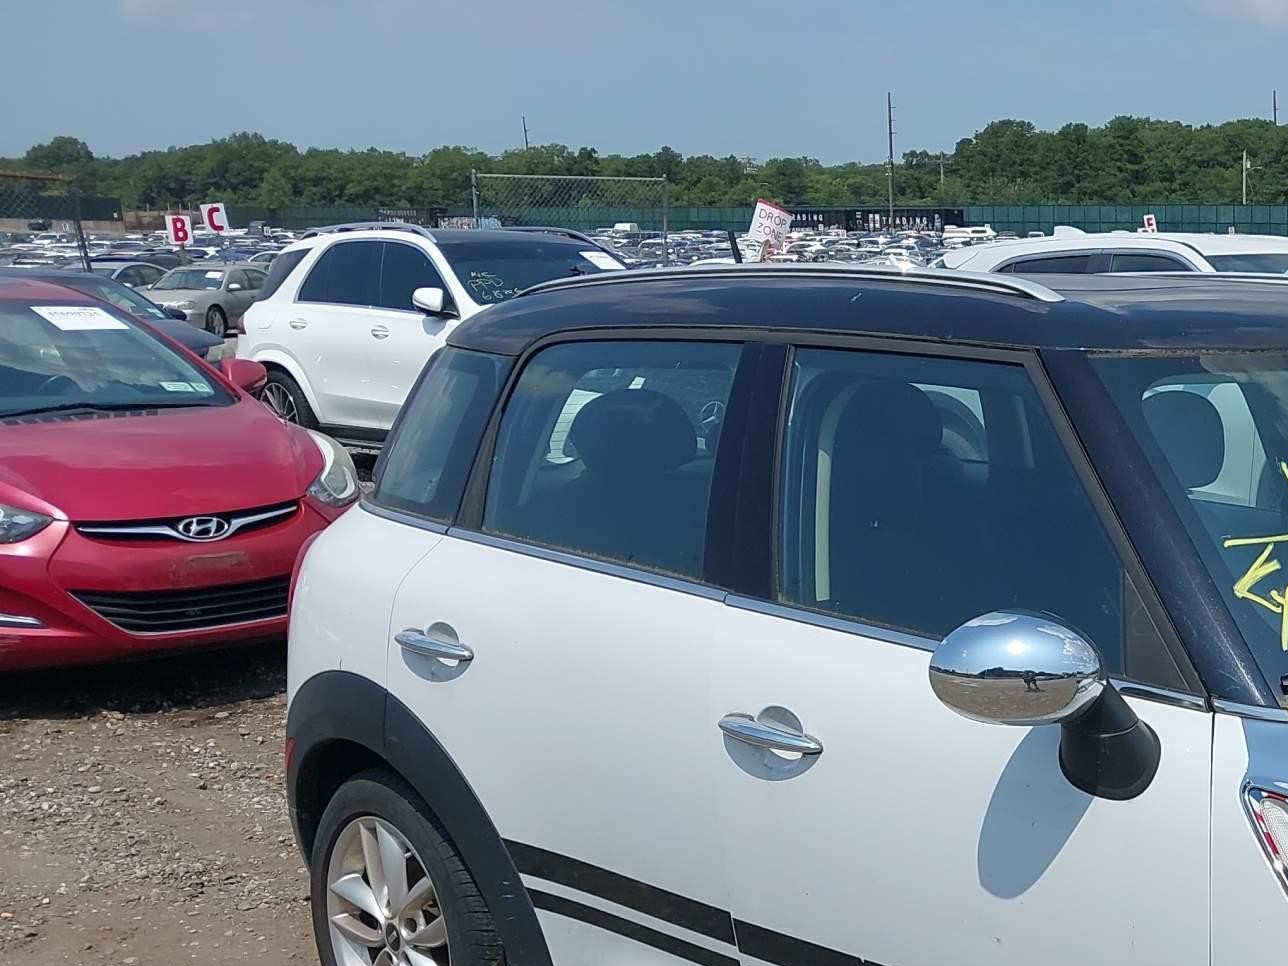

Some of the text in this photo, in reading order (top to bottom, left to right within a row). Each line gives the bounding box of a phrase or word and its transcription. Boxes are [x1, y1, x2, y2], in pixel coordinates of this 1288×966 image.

[171, 217, 188, 242] B
[207, 206, 224, 231] C
[758, 208, 787, 228] DROP
[757, 222, 783, 244] ZONE
